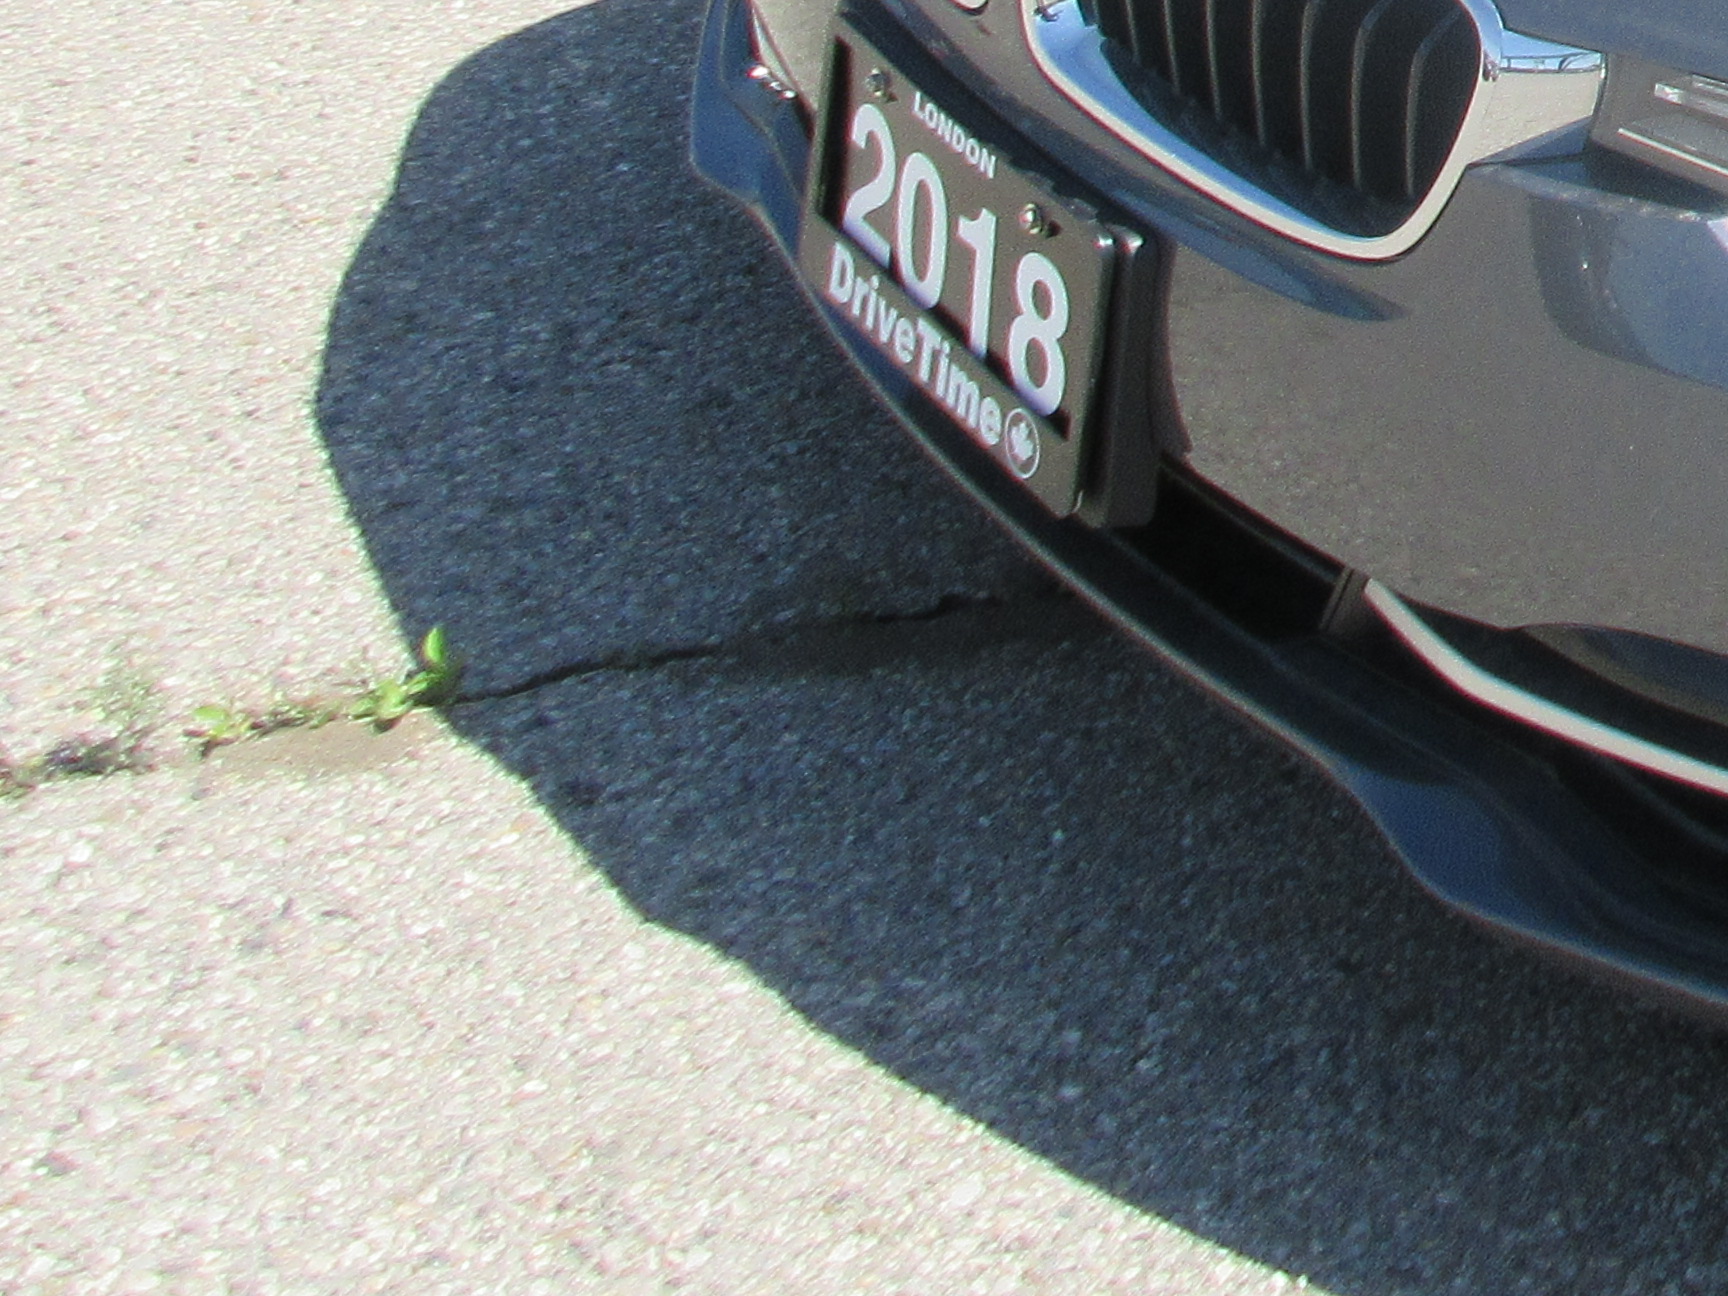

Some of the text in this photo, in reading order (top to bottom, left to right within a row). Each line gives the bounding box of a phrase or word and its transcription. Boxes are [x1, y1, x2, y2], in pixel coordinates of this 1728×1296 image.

[913, 90, 996, 180] LONDON
[828, 240, 1002, 448] DriveTime
[842, 103, 1070, 417] 2018
